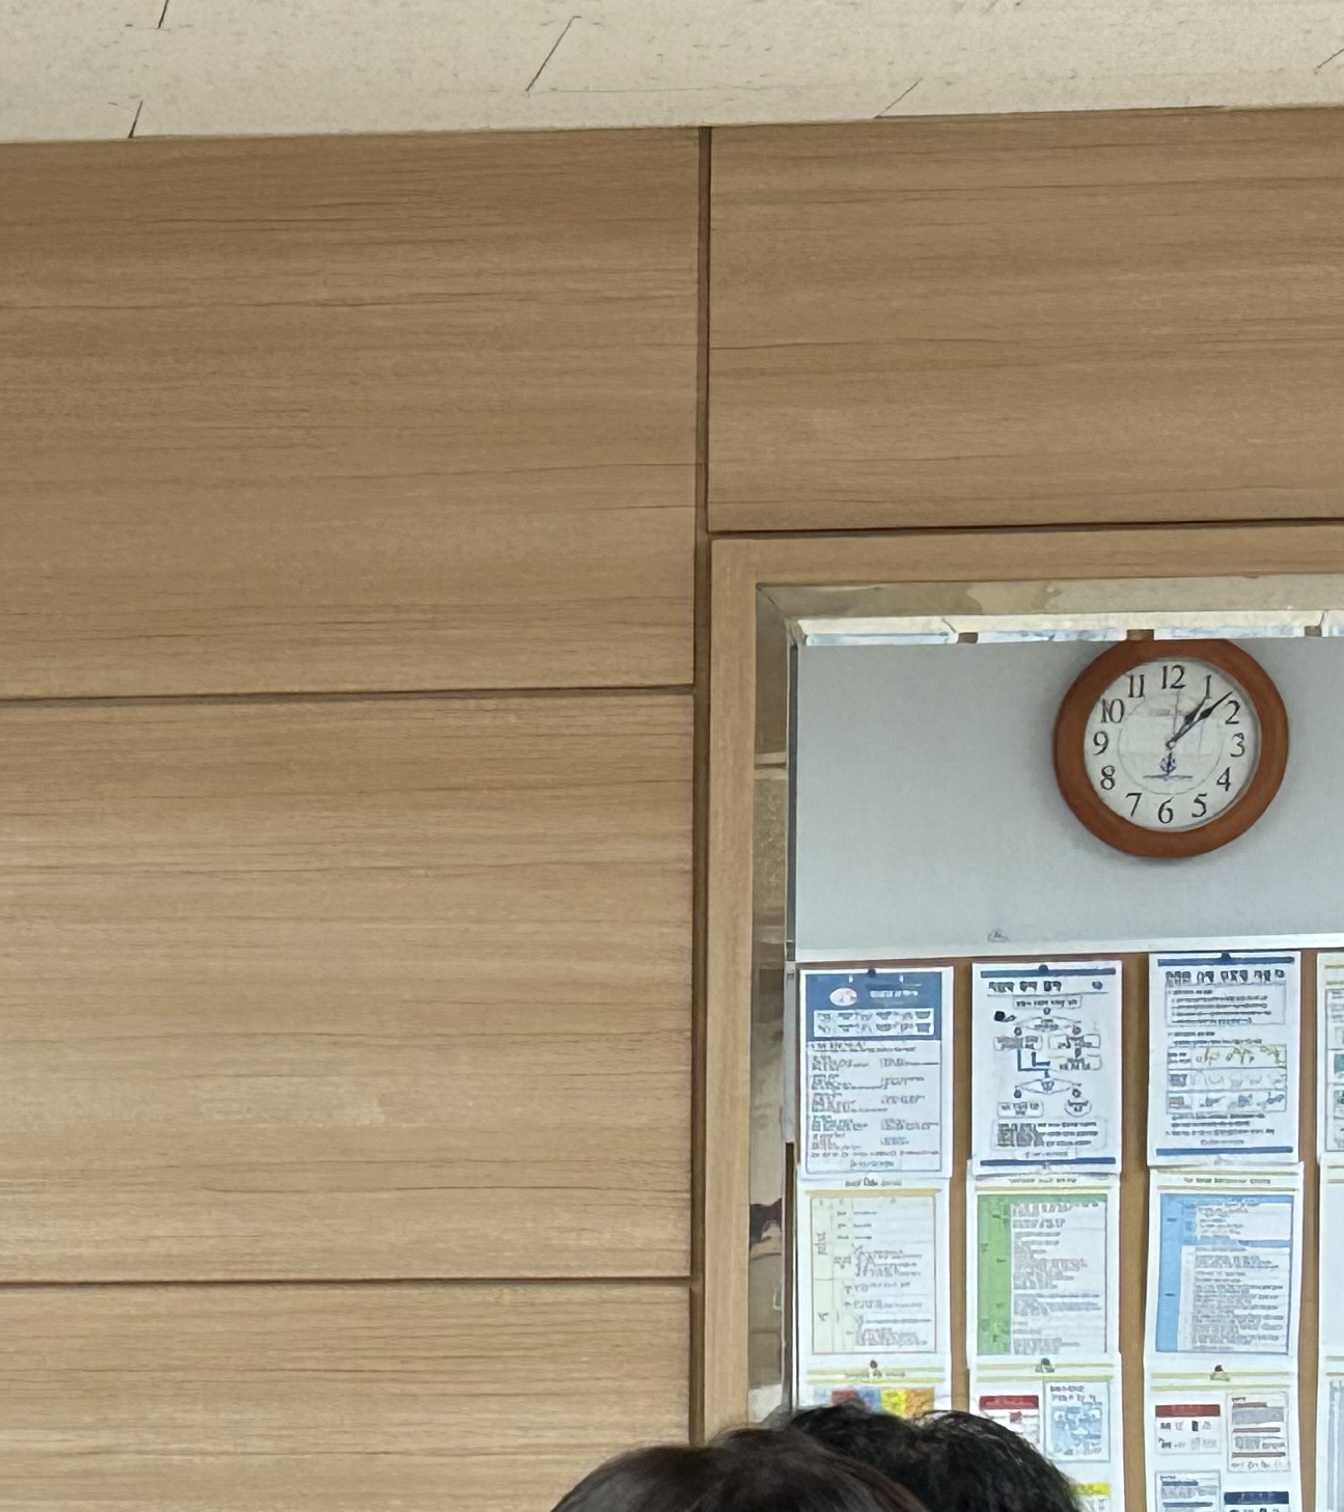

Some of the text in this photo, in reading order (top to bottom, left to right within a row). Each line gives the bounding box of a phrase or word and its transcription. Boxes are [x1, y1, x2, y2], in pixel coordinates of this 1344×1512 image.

[1127, 674, 1146, 699] 11
[1161, 664, 1187, 690] 12
[1203, 674, 1213, 699] 1
[1099, 698, 1125, 724] 10
[1224, 699, 1241, 725] 2
[1092, 730, 1109, 756] 9
[1229, 732, 1246, 758] 3
[1099, 765, 1117, 791] 8
[1216, 766, 1232, 792] 4
[1125, 792, 1143, 818] 7
[1157, 796, 1175, 824] 6
[1191, 792, 1209, 818] 5
